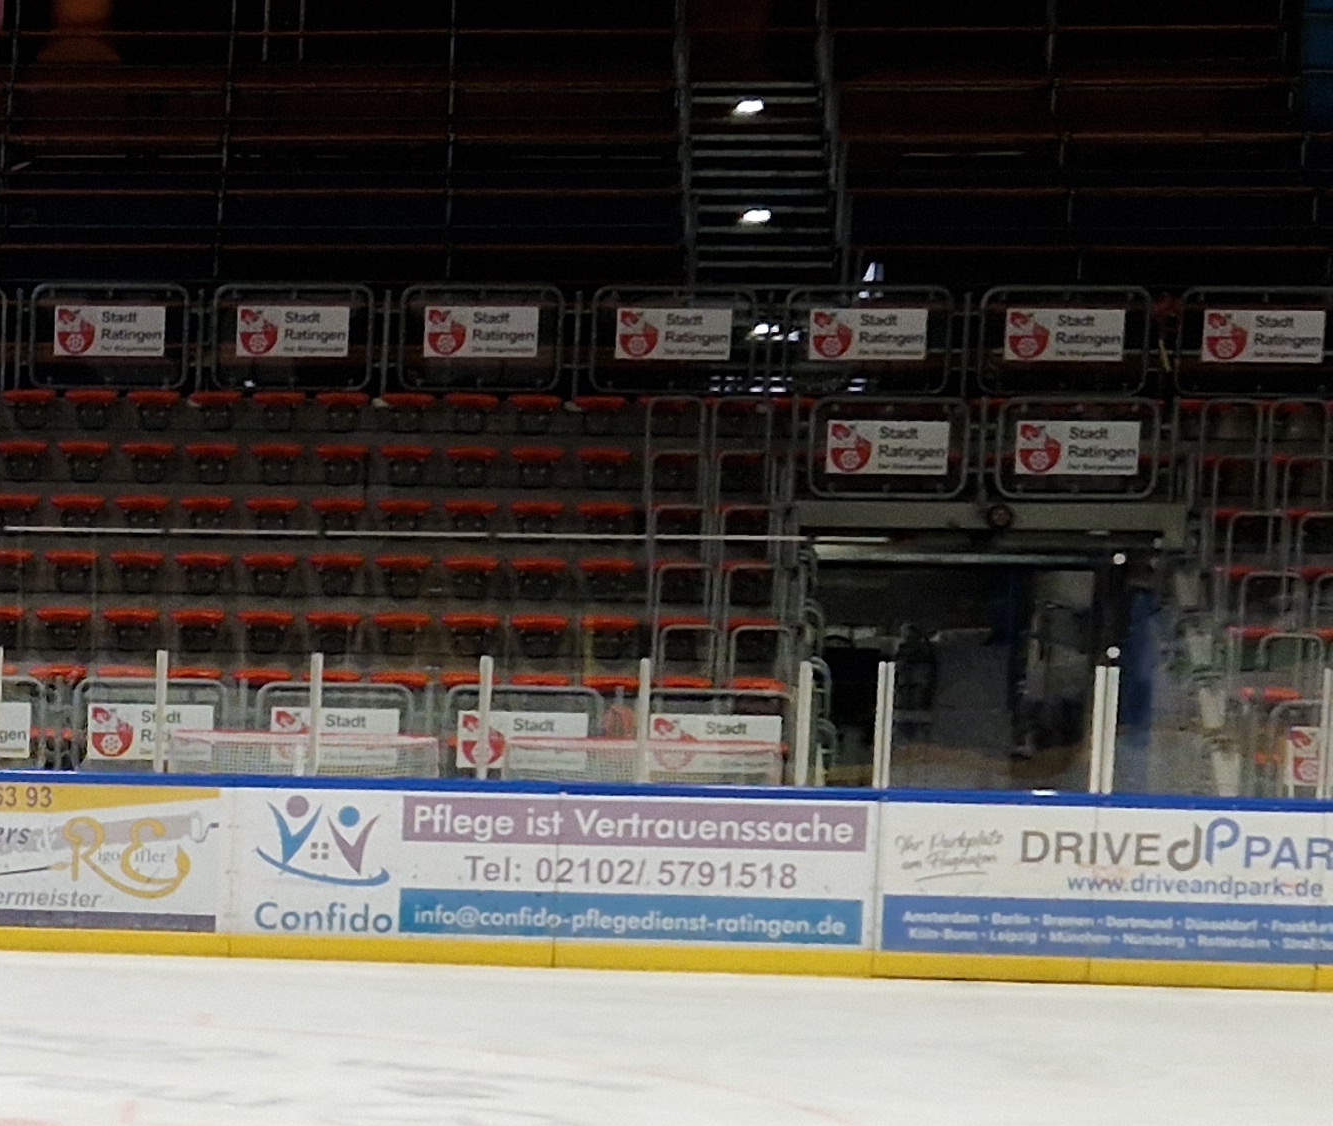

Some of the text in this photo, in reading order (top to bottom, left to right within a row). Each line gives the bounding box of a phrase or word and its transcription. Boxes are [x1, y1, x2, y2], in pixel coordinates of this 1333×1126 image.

[101, 312, 137, 323] Stadt
[285, 312, 320, 323] Stadt
[473, 312, 509, 323] Stadt
[667, 314, 702, 325] Stadt
[860, 314, 897, 326] Stadt
[1057, 315, 1095, 326] Stadt
[1255, 315, 1294, 327] Stadt
[101, 329, 161, 343] Ratingen
[285, 329, 345, 343] Ratingen
[473, 330, 533, 343] Ratingen
[665, 331, 728, 345] Ratingen
[859, 332, 924, 346] Ratingen
[1056, 333, 1121, 346] Ratingen
[1254, 333, 1321, 348] Ratingen
[879, 426, 918, 439] Stadt
[1069, 426, 1108, 440] Stadt
[878, 444, 944, 460] Ratingen
[1068, 444, 1135, 460] Ratingen
[141, 710, 181, 724] Stdt
[325, 714, 366, 728] Stadt
[513, 718, 554, 732] Stadt
[706, 721, 747, 734] Stadt
[26, 787, 52, 808] 93
[413, 806, 853, 844] Pflege ist Vertrauenssache
[1020, 830, 1161, 865] DRIVE
[1245, 836, 1333, 870] PAR
[464, 856, 797, 889] Tel: 02102/ 5791518
[1068, 873, 1323, 898] www.driveandpark.de
[255, 902, 392, 933] Confido
[413, 904, 846, 938] info@confido-pflegedienst-ratingen.de
